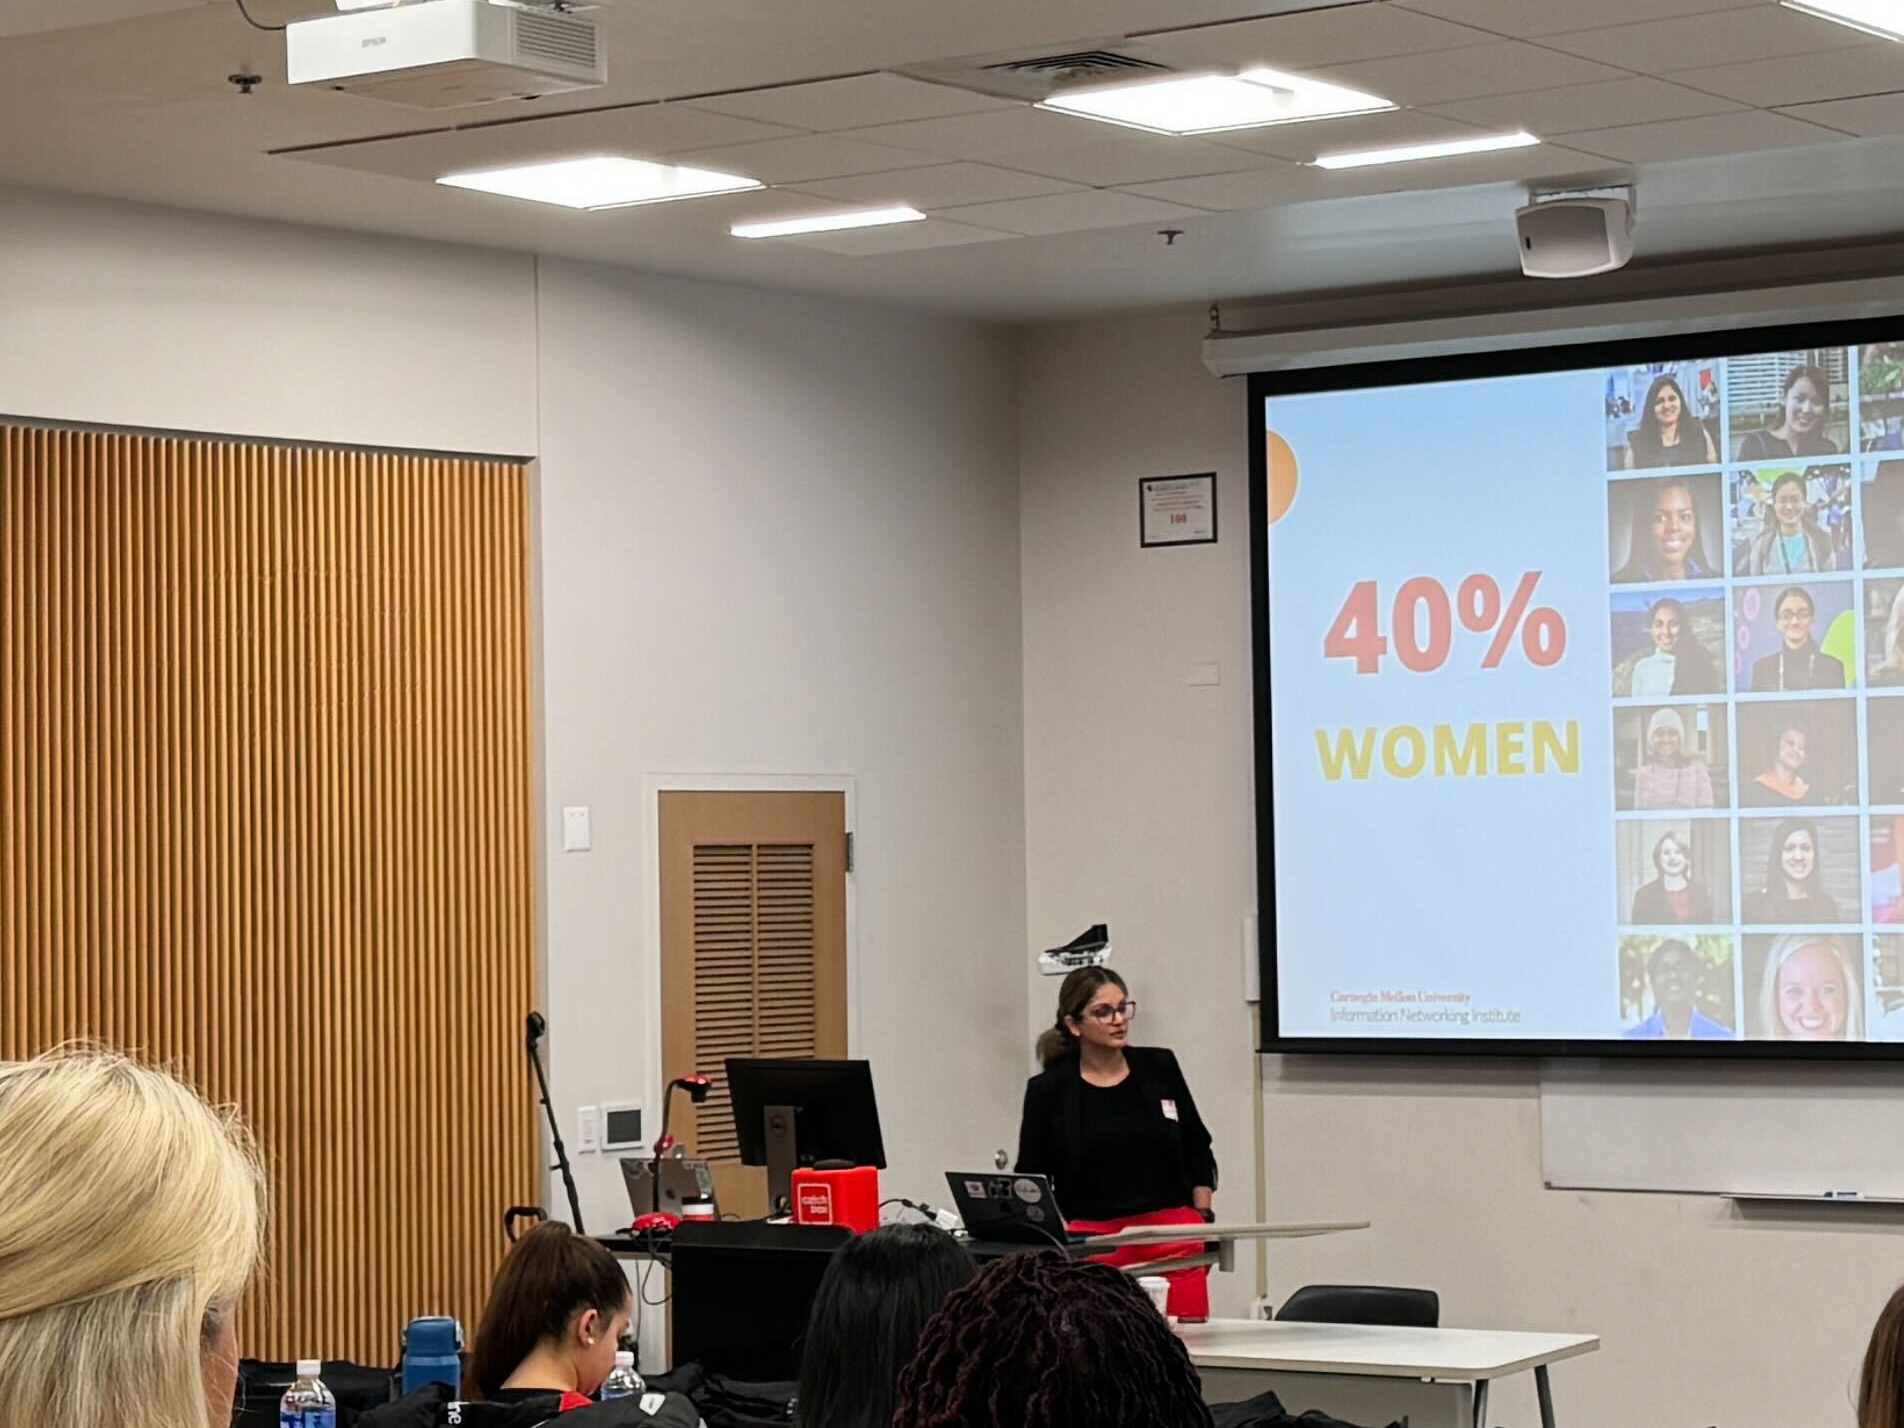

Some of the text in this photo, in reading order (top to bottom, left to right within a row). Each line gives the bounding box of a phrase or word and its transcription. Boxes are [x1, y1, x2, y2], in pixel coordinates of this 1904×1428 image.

[1323, 571, 1568, 676] 40%
[1314, 720, 1583, 781] WOMEN
[1330, 1007, 1521, 1026] Information Networking Institute
